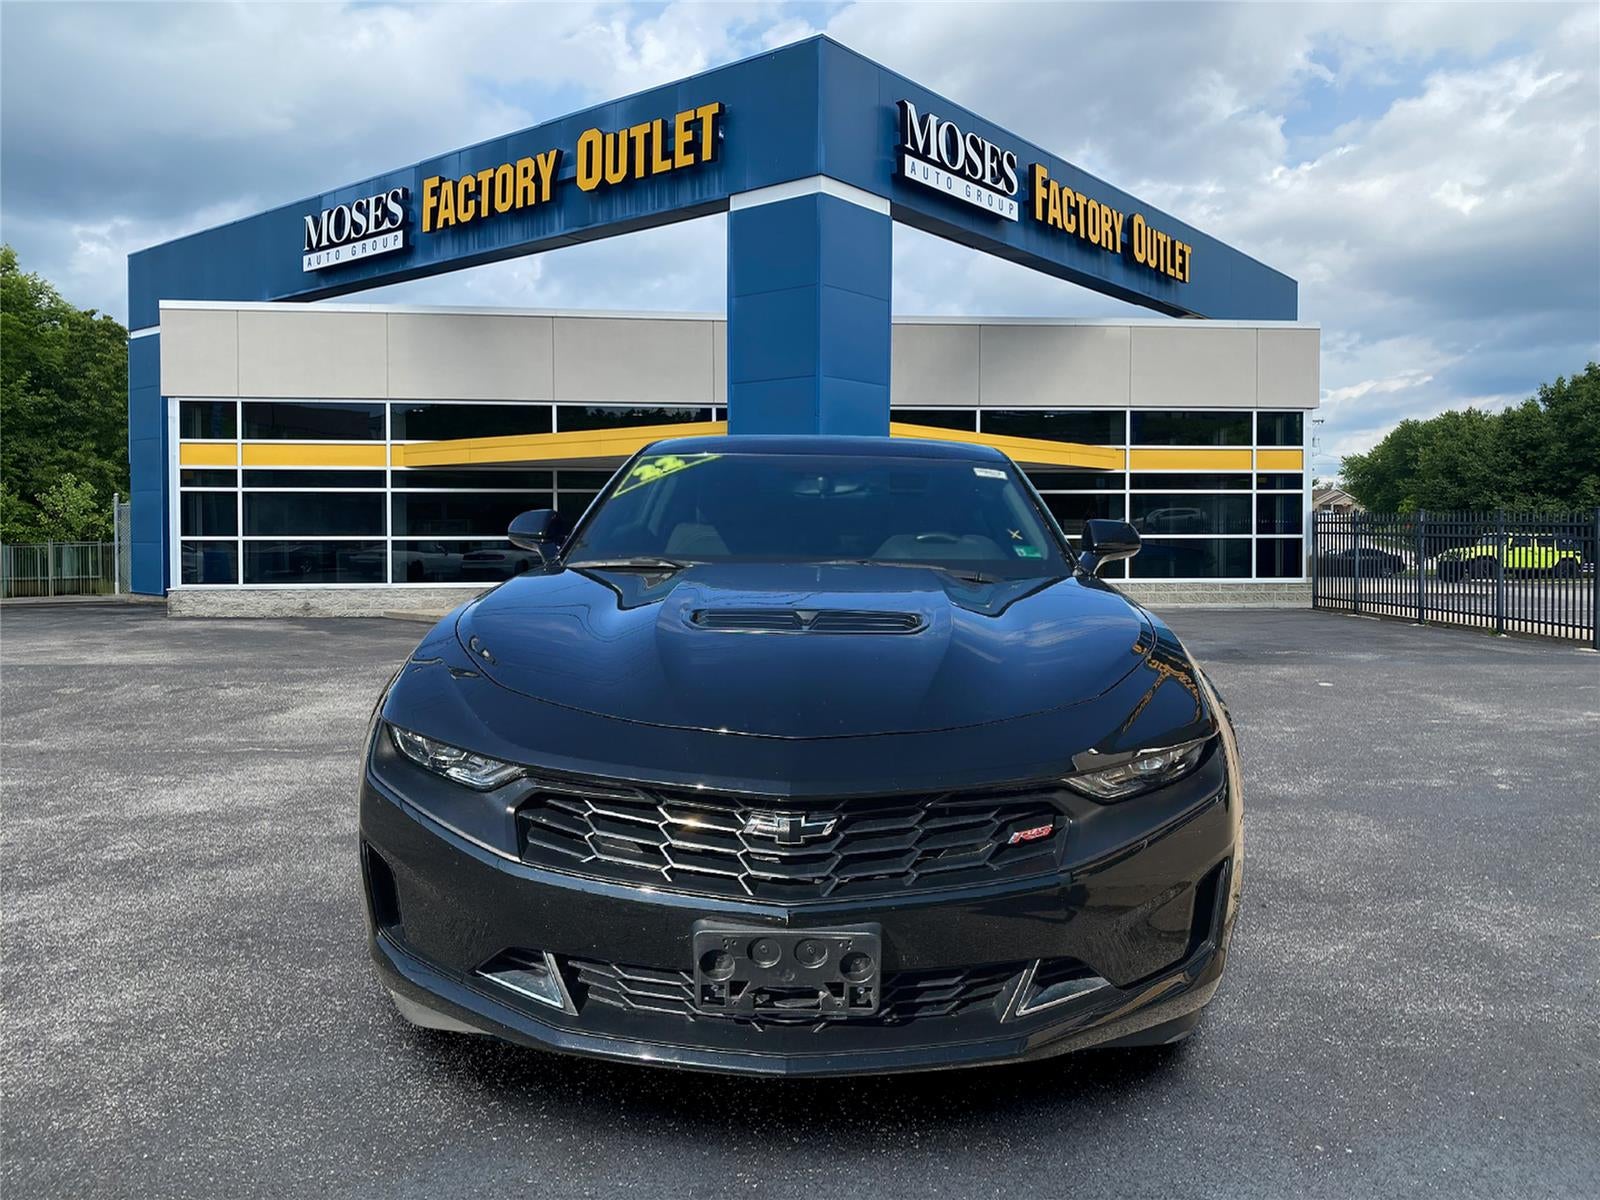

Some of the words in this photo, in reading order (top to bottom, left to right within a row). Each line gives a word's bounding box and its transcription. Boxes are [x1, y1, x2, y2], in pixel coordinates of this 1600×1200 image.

[421, 148, 560, 233] FACTORY
[575, 102, 721, 193] OUTLET
[904, 101, 1018, 196] MOSES
[910, 160, 954, 191] AUTO
[964, 184, 1016, 216] GROUP
[303, 187, 405, 253] MOSES
[306, 248, 342, 269] AUTO
[350, 235, 401, 257] GROUP
[1034, 162, 1125, 254] FACTORY
[1131, 212, 1193, 284] OUTLET
